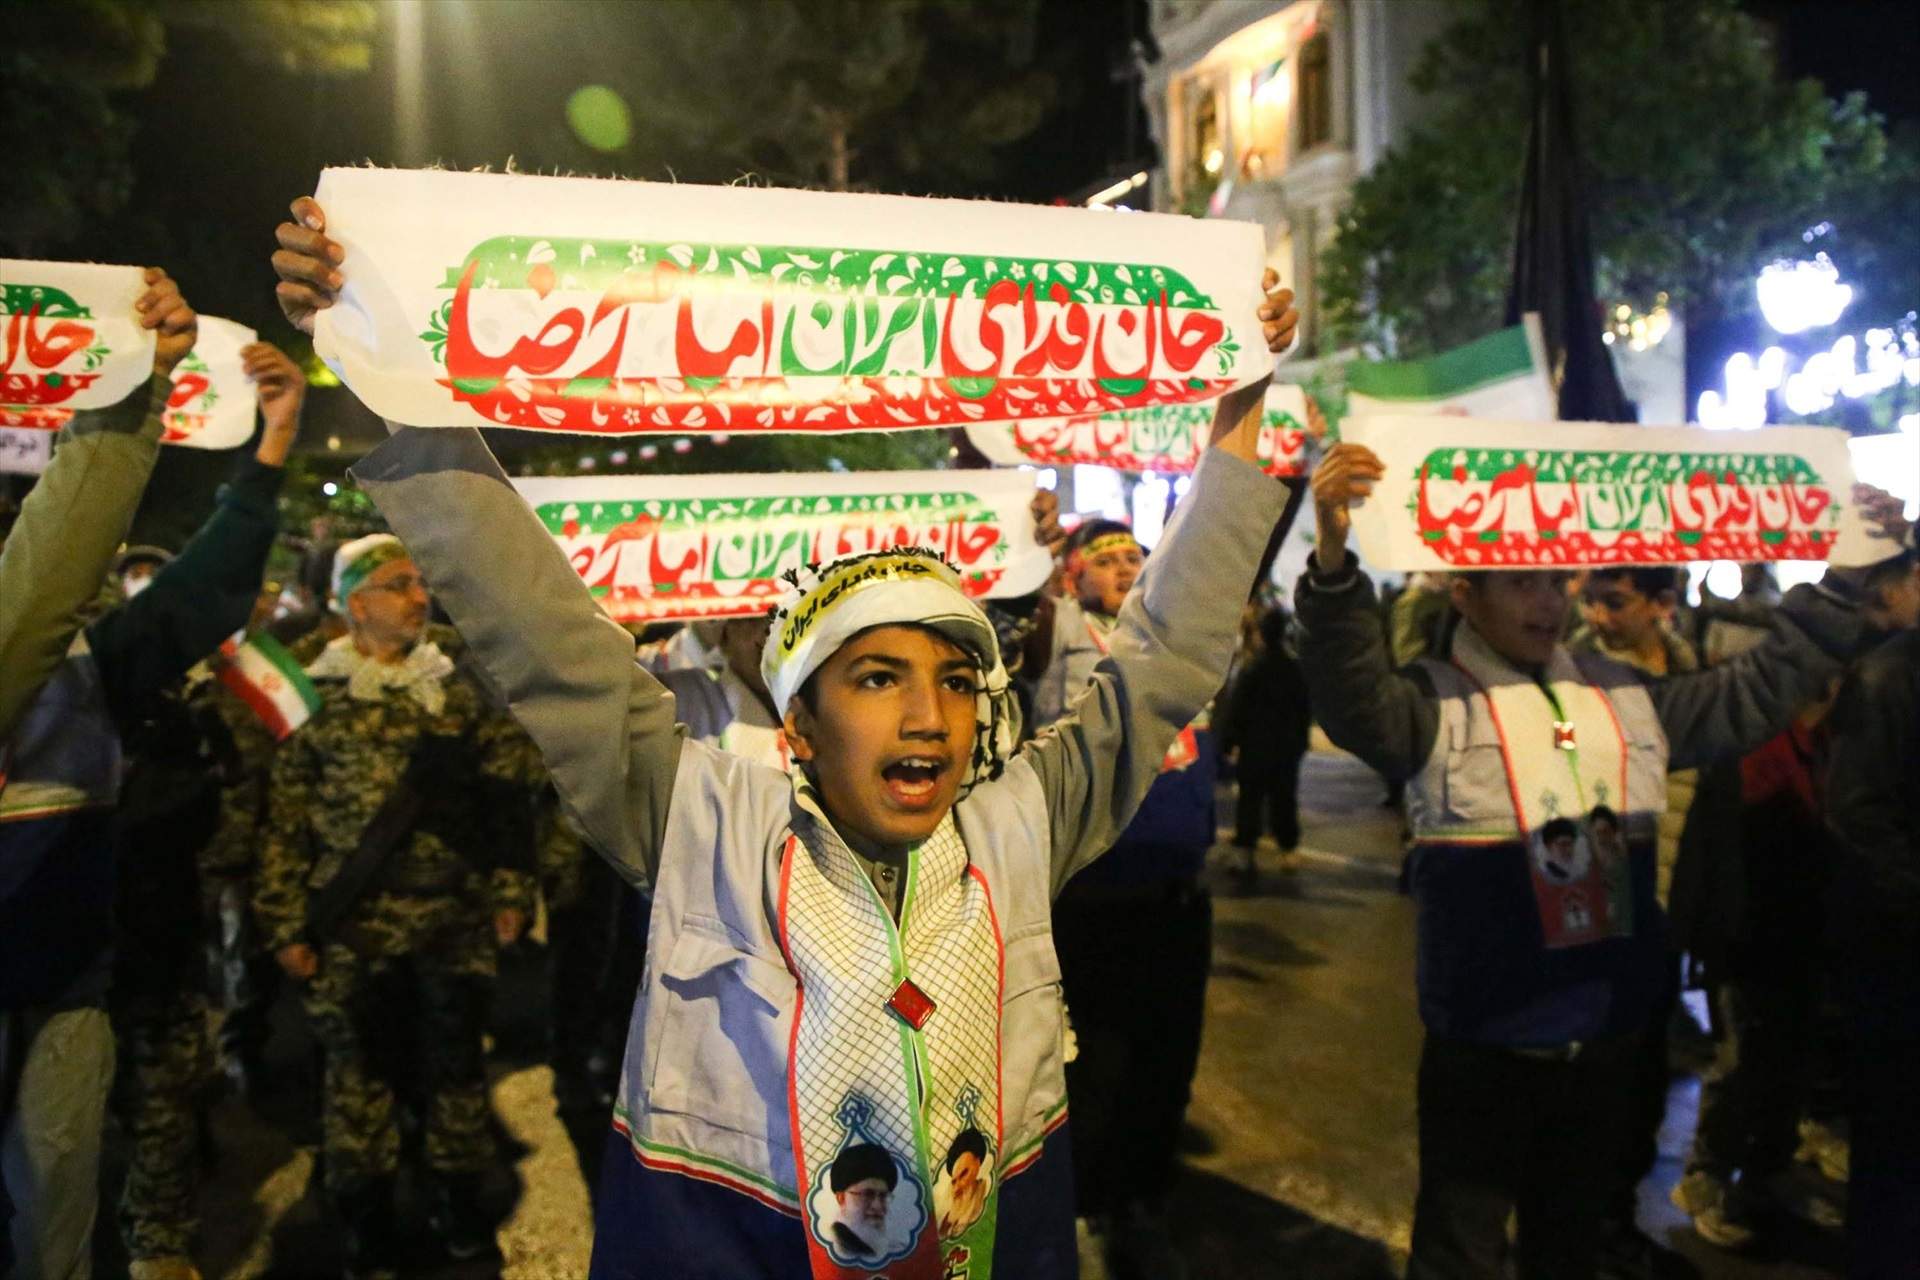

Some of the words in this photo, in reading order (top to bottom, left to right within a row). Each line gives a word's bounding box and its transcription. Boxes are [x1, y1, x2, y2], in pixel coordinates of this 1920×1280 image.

[0, 302, 95, 387] جا
[445, 258, 630, 397] رضا
[779, 274, 938, 394] ایران
[940, 279, 1092, 399] فدای
[1094, 286, 1225, 395] جان
[1586, 470, 1668, 547] ایران
[1669, 470, 1754, 545] فدای
[1757, 473, 1830, 545] جان
